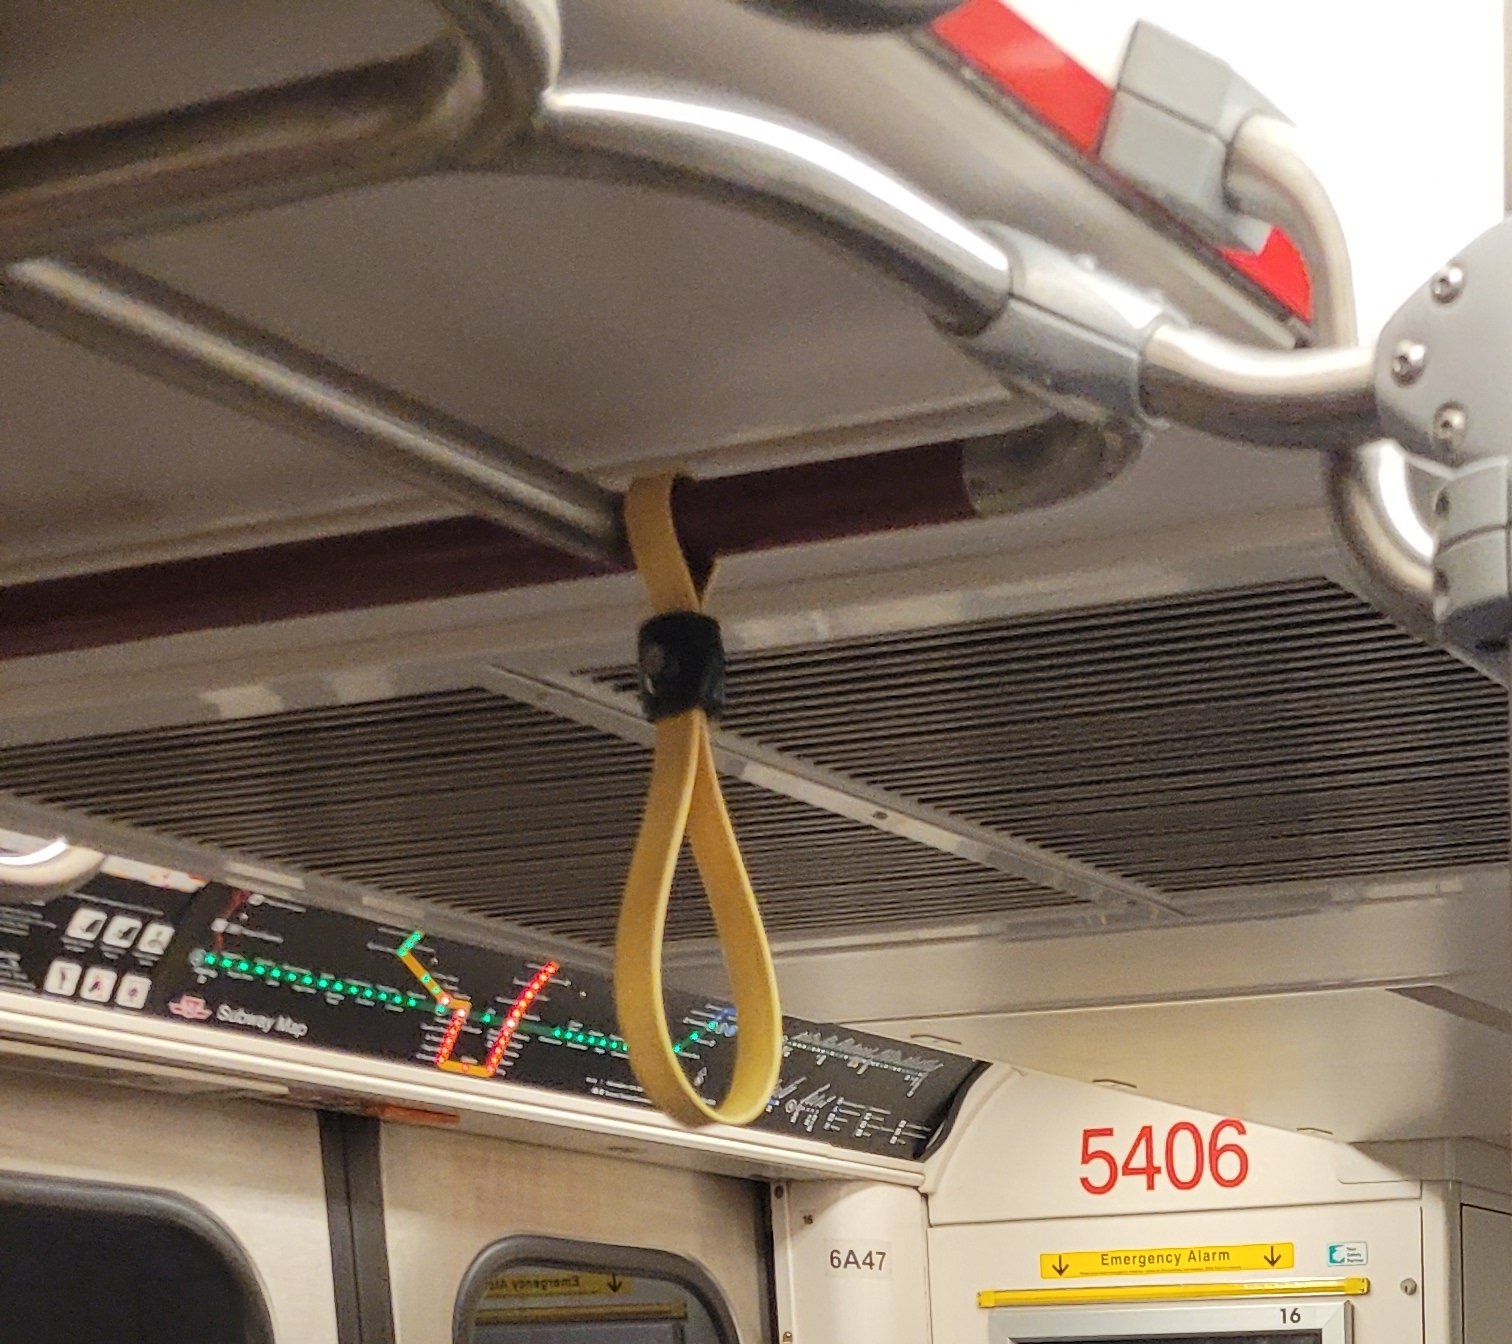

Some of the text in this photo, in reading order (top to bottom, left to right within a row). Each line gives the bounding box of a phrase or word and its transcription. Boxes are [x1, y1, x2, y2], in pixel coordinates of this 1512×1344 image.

[216, 1003, 276, 1033] Subway
[273, 1014, 308, 1039] Map
[1080, 1118, 1249, 1195] 5406
[829, 1249, 887, 1271] 6A47
[1100, 1249, 1231, 1268] Emergency Alarm
[1280, 1307, 1301, 1324] 16
